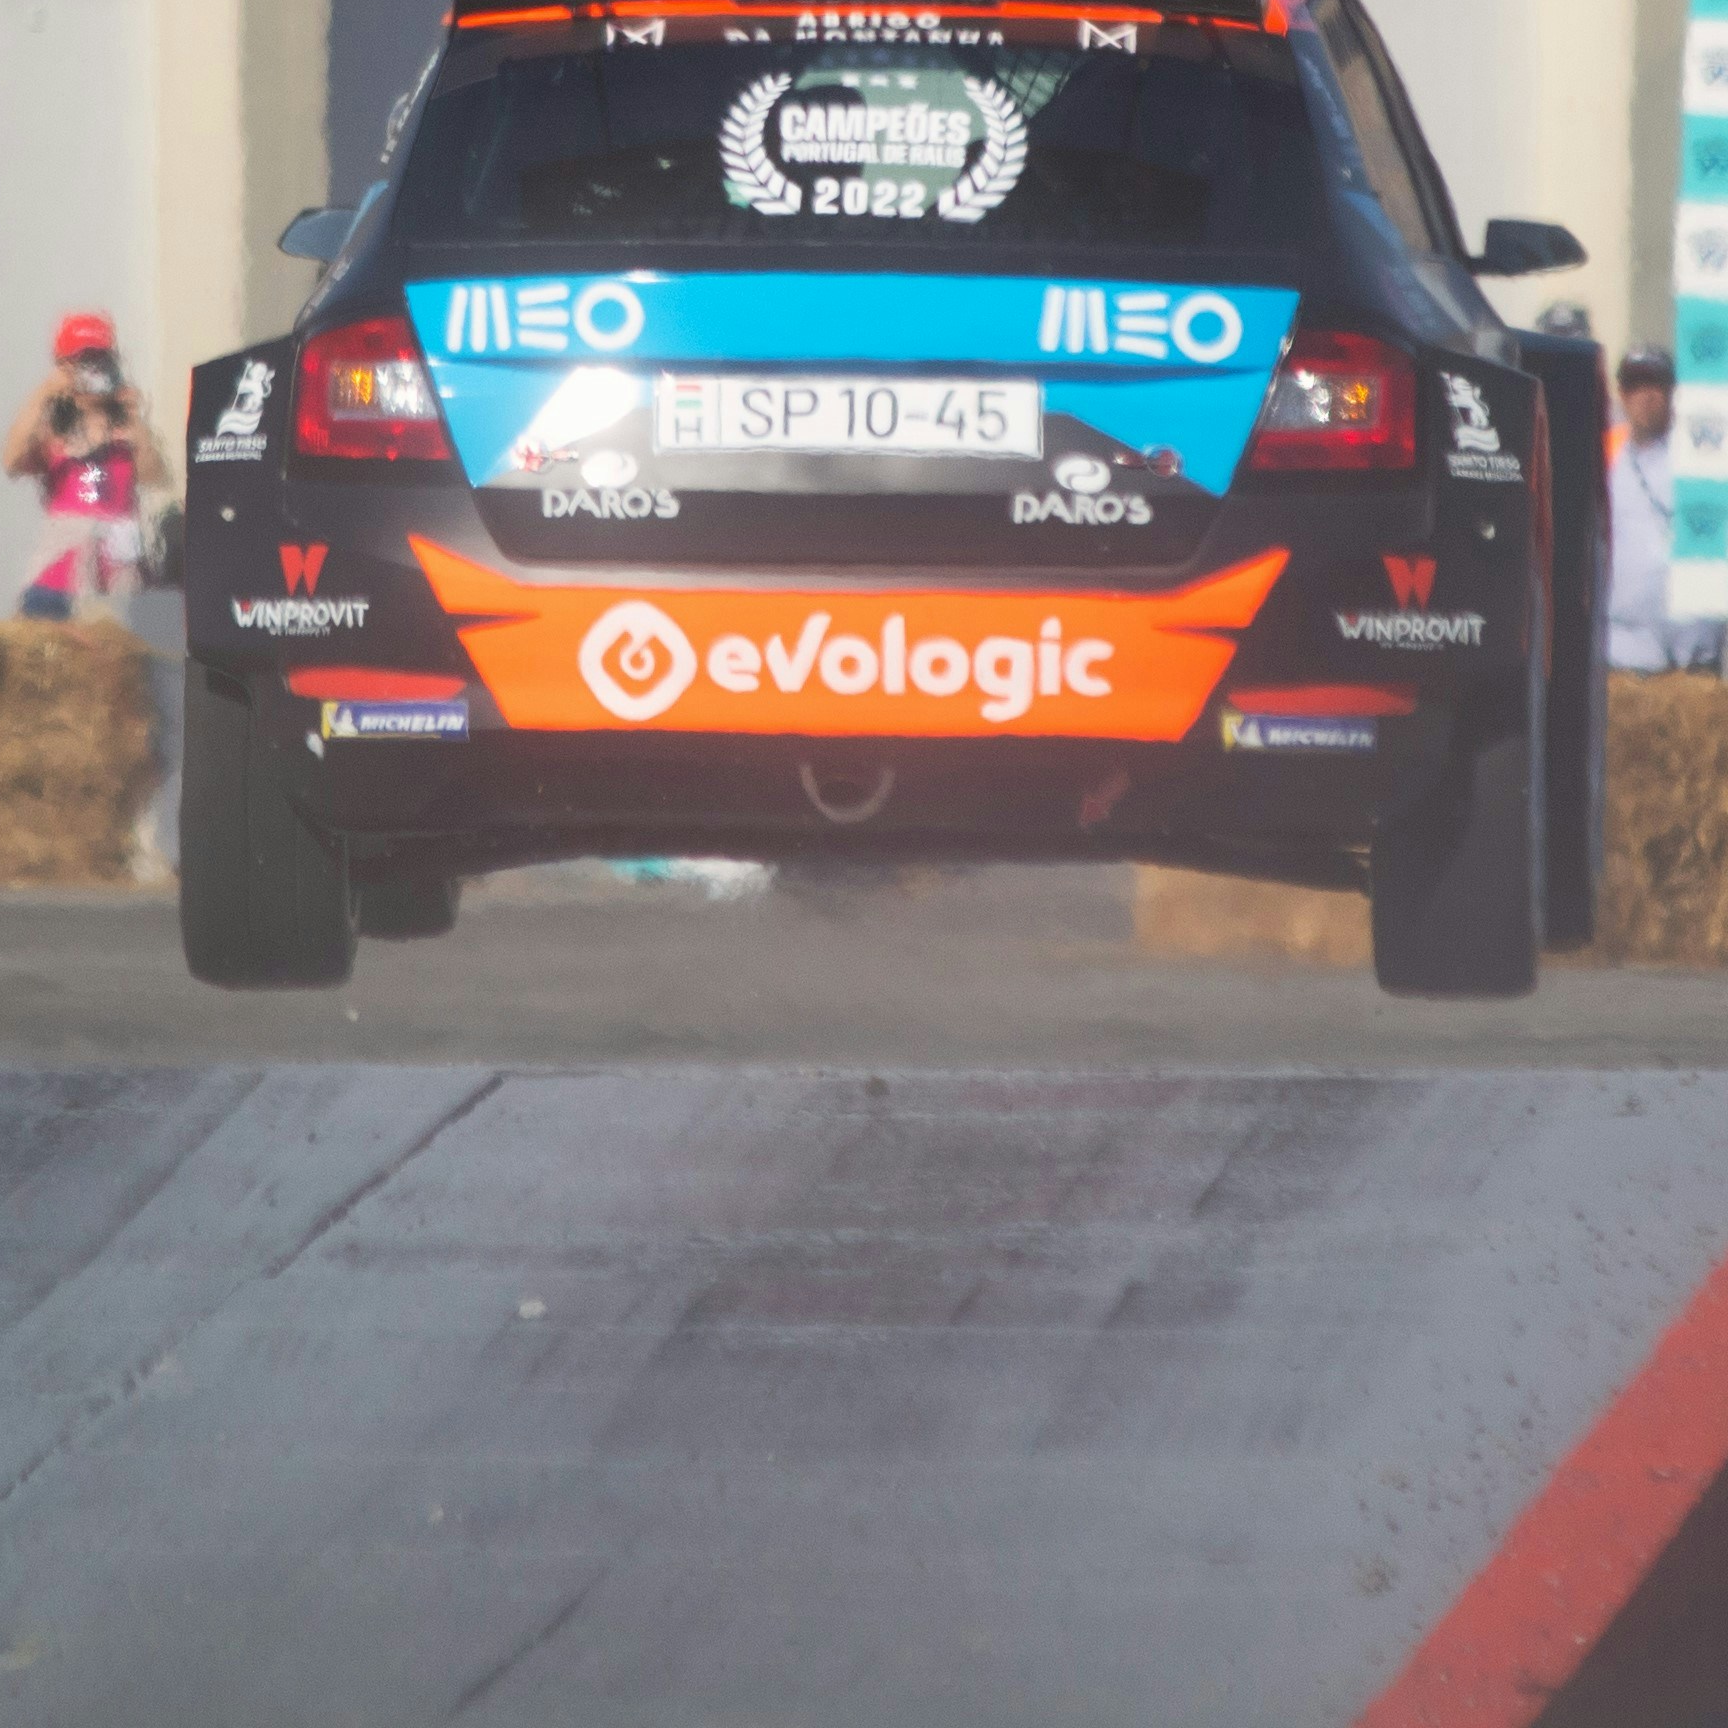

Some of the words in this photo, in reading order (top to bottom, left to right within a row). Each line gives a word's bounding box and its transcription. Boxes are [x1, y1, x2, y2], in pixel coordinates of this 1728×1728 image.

[780, 103, 971, 146] CAMPEÕES
[781, 141, 880, 164] PORTUGAL
[813, 177, 926, 219] 2022
[445, 282, 645, 354] MEO
[1038, 284, 1244, 364] MEO
[740, 387, 820, 438] SP
[838, 387, 1008, 442] 10-45
[542, 487, 681, 519] DARO'S
[1013, 491, 1154, 524] DARO'S
[231, 599, 370, 629] WINPROVIT
[1335, 612, 1486, 645] WINPROVIT
[360, 714, 465, 732] MICHELIN
